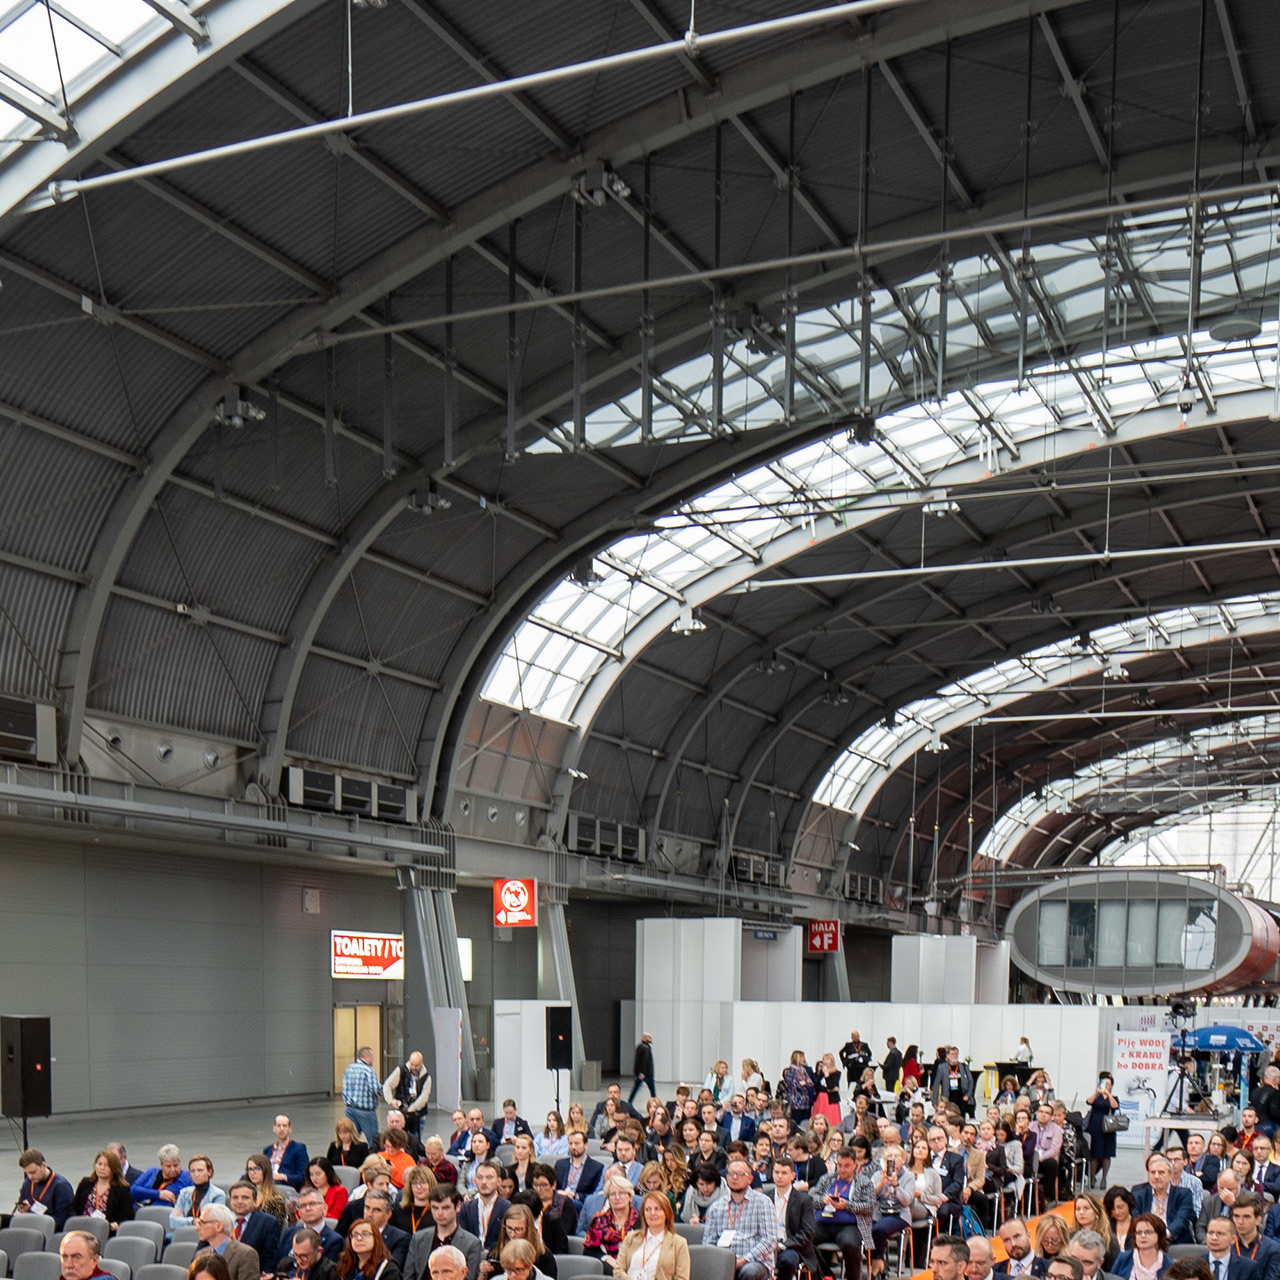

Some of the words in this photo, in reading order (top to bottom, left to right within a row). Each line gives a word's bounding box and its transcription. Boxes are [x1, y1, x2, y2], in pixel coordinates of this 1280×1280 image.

[811, 922, 836, 932] HALA
[334, 936, 384, 957] TOALETY
[823, 933, 833, 950] F
[1139, 1039, 1166, 1050] WODĘ
[1128, 1050, 1162, 1060] KRANU
[1117, 1061, 1128, 1070] bo
[1131, 1062, 1164, 1071] DOBRA
